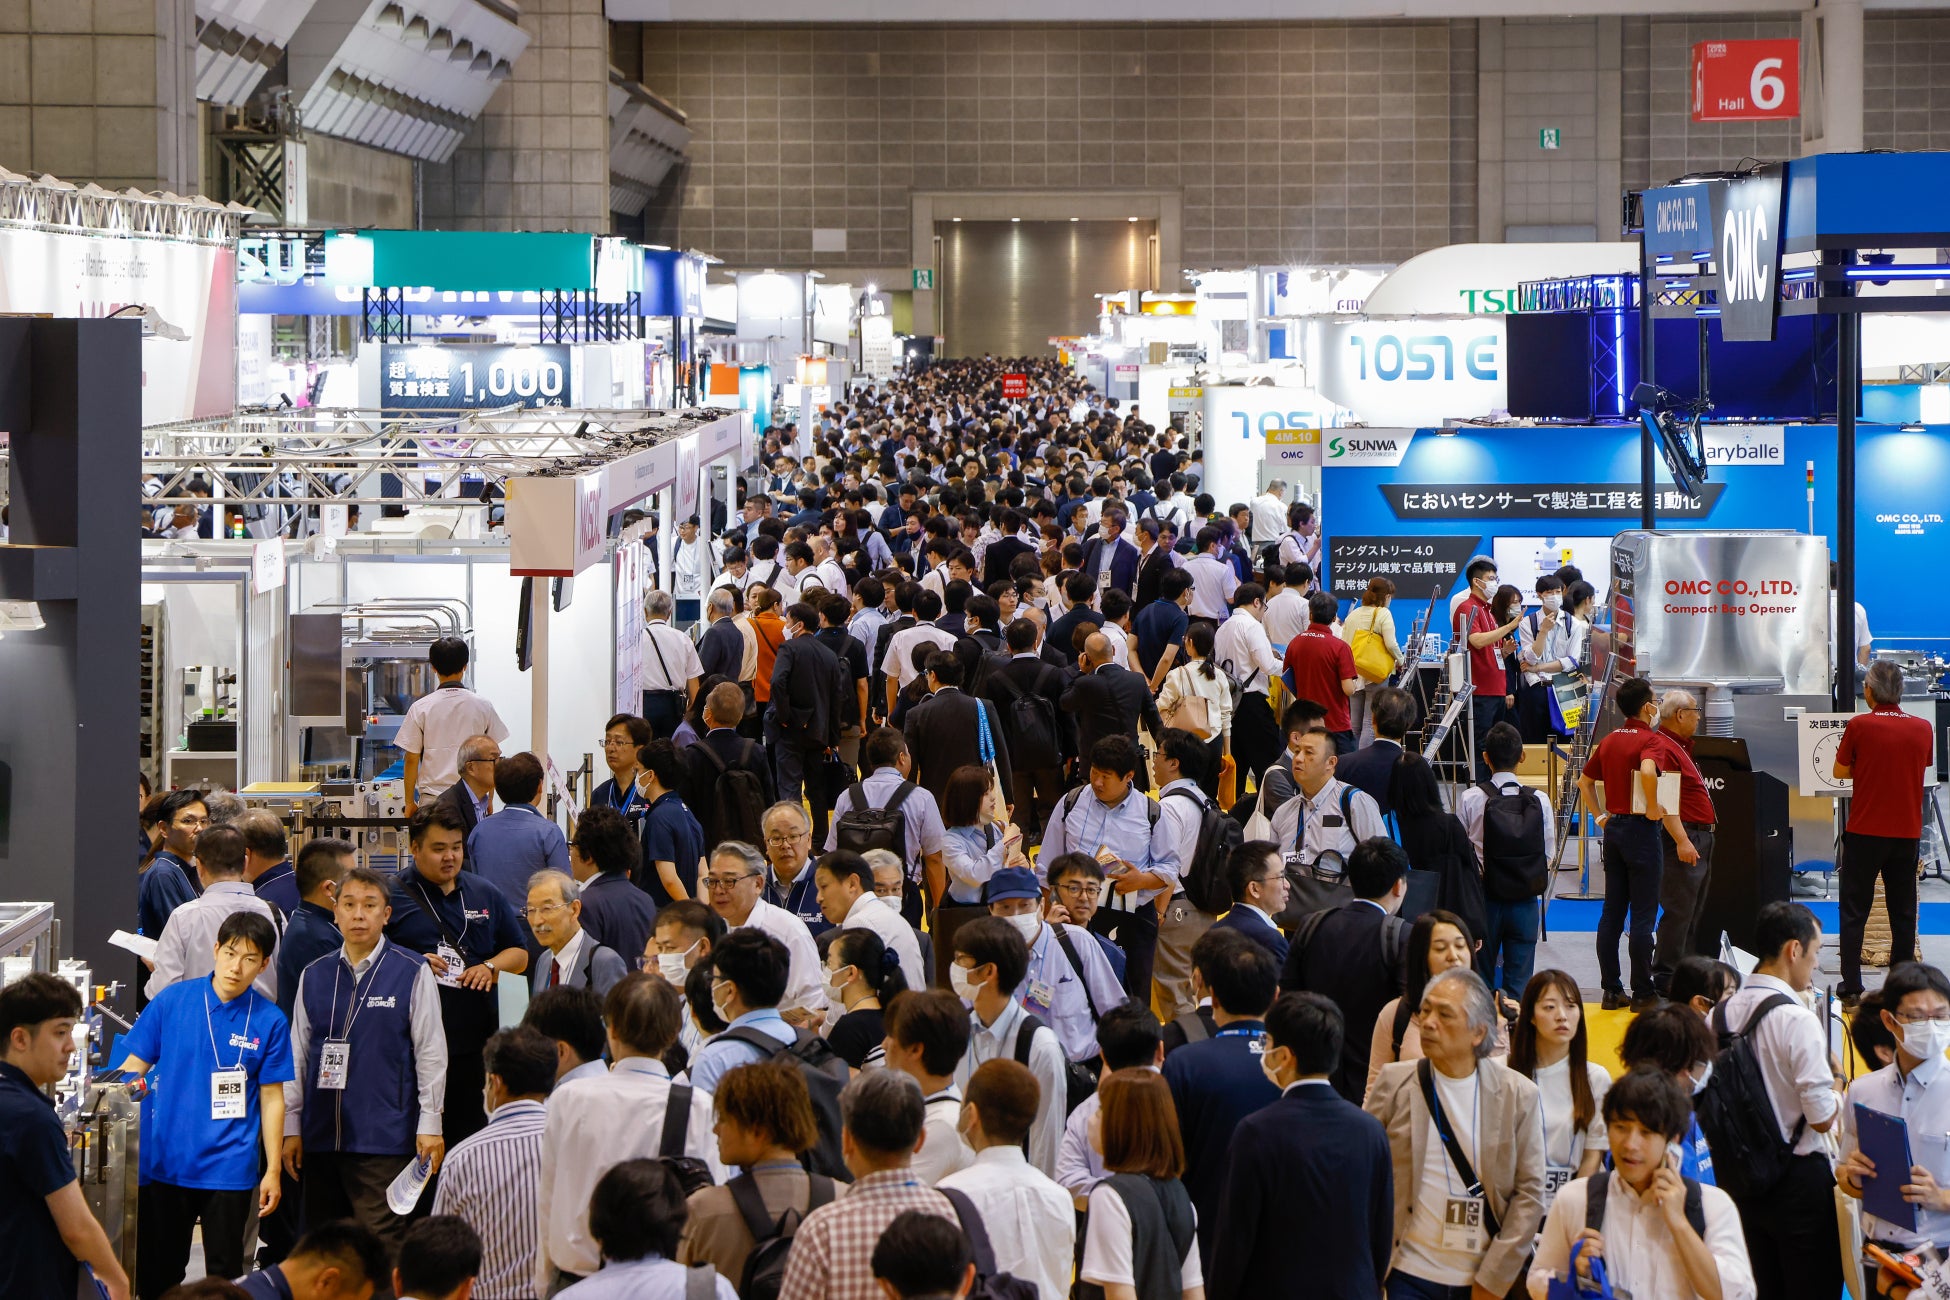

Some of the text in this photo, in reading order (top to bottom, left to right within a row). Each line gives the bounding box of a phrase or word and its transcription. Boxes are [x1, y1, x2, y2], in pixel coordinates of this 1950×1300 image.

[1718, 57, 1786, 111] Hall 6
[1656, 200, 1672, 234] OMC
[1723, 203, 1768, 304] OMC
[459, 361, 564, 402] 1,000
[1273, 432, 1313, 443] 4M-10
[1348, 439, 1397, 451] SUNWA
[1280, 451, 1304, 459] OMC
[1706, 443, 1779, 462] aryballe
[1875, 514, 1901, 523] OMC
[1334, 545, 1434, 557] インダストリー 4.0
[1334, 579, 1371, 591] 異常検
[1664, 580, 1712, 596] OMC
[1664, 603, 1797, 616] Compact Bag Opener
[1814, 756, 1820, 764] 9
[1704, 777, 1725, 790] MC
[1450, 1203, 1461, 1223] 1
